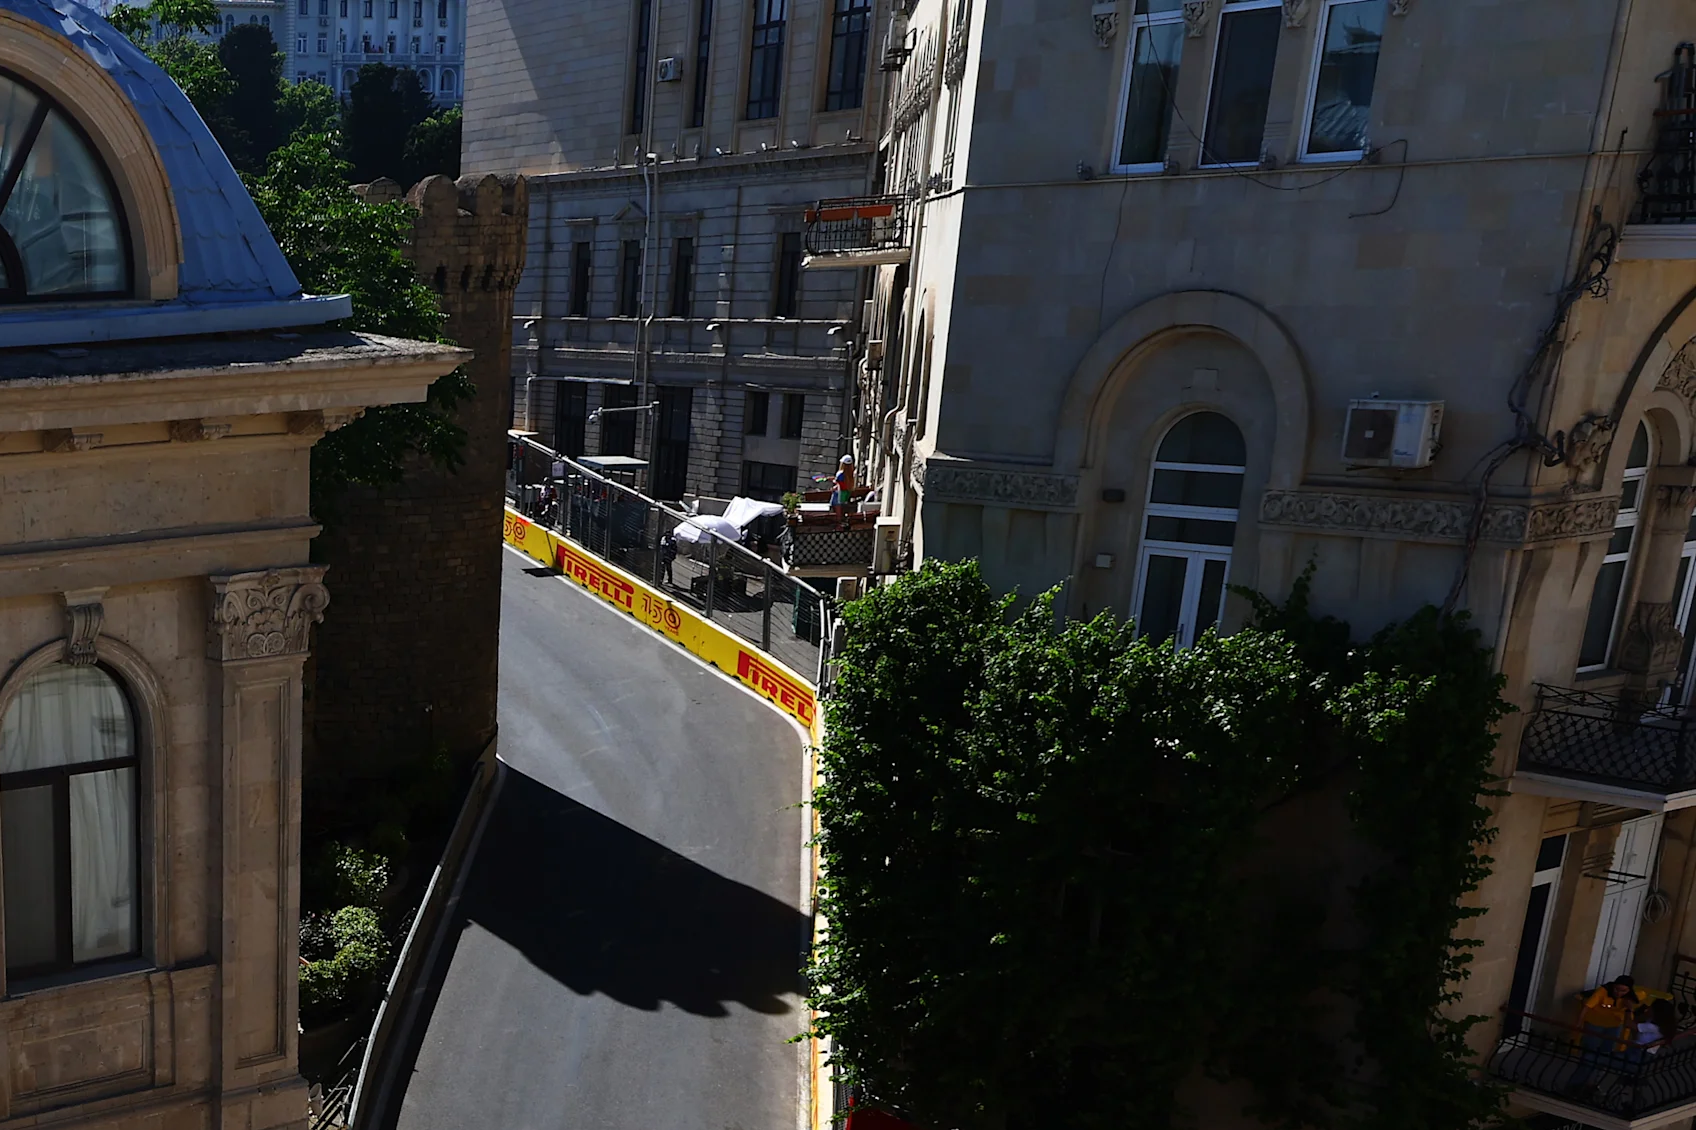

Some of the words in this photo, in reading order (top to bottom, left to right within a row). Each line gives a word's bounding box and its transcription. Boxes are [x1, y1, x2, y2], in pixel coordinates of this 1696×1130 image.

[504, 514, 525, 540] 50
[556, 543, 634, 609] PIRELLI
[642, 592, 681, 630] 150
[737, 650, 814, 723] PIREL
